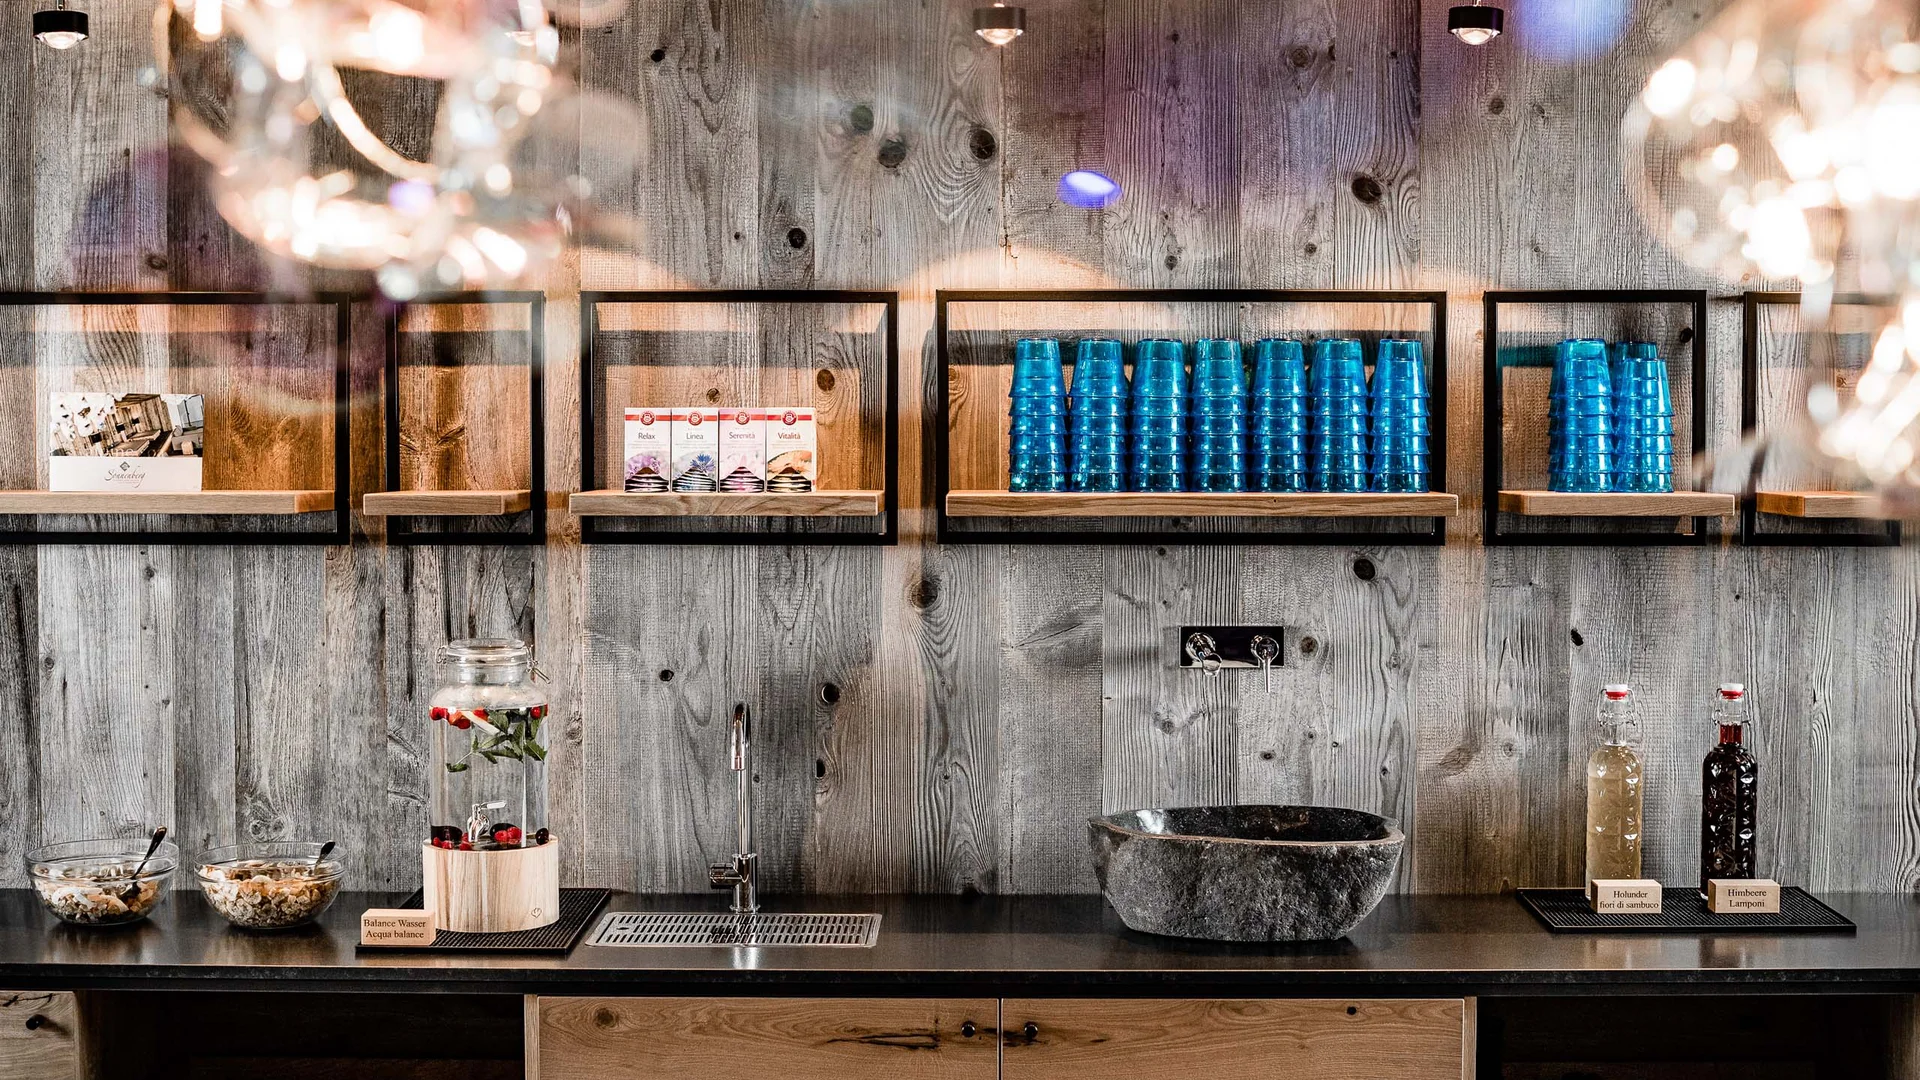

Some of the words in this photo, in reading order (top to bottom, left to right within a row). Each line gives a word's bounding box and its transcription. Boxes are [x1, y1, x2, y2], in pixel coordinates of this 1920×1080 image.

[638, 432, 655, 440] Relax
[686, 432, 704, 440] Linea
[729, 431, 756, 440] Serenità
[778, 431, 801, 440] Vitalità
[1613, 890, 1648, 899] Holunder
[1727, 888, 1767, 897] Himbeere
[1599, 900, 1615, 909] fiori
[1616, 900, 1625, 909] di
[1626, 900, 1659, 909] sambuco
[1729, 899, 1765, 908] Lamponi
[364, 919, 396, 928] Balance
[398, 919, 426, 928] Wasser
[366, 930, 392, 939] Acqua
[394, 930, 424, 938] balance
